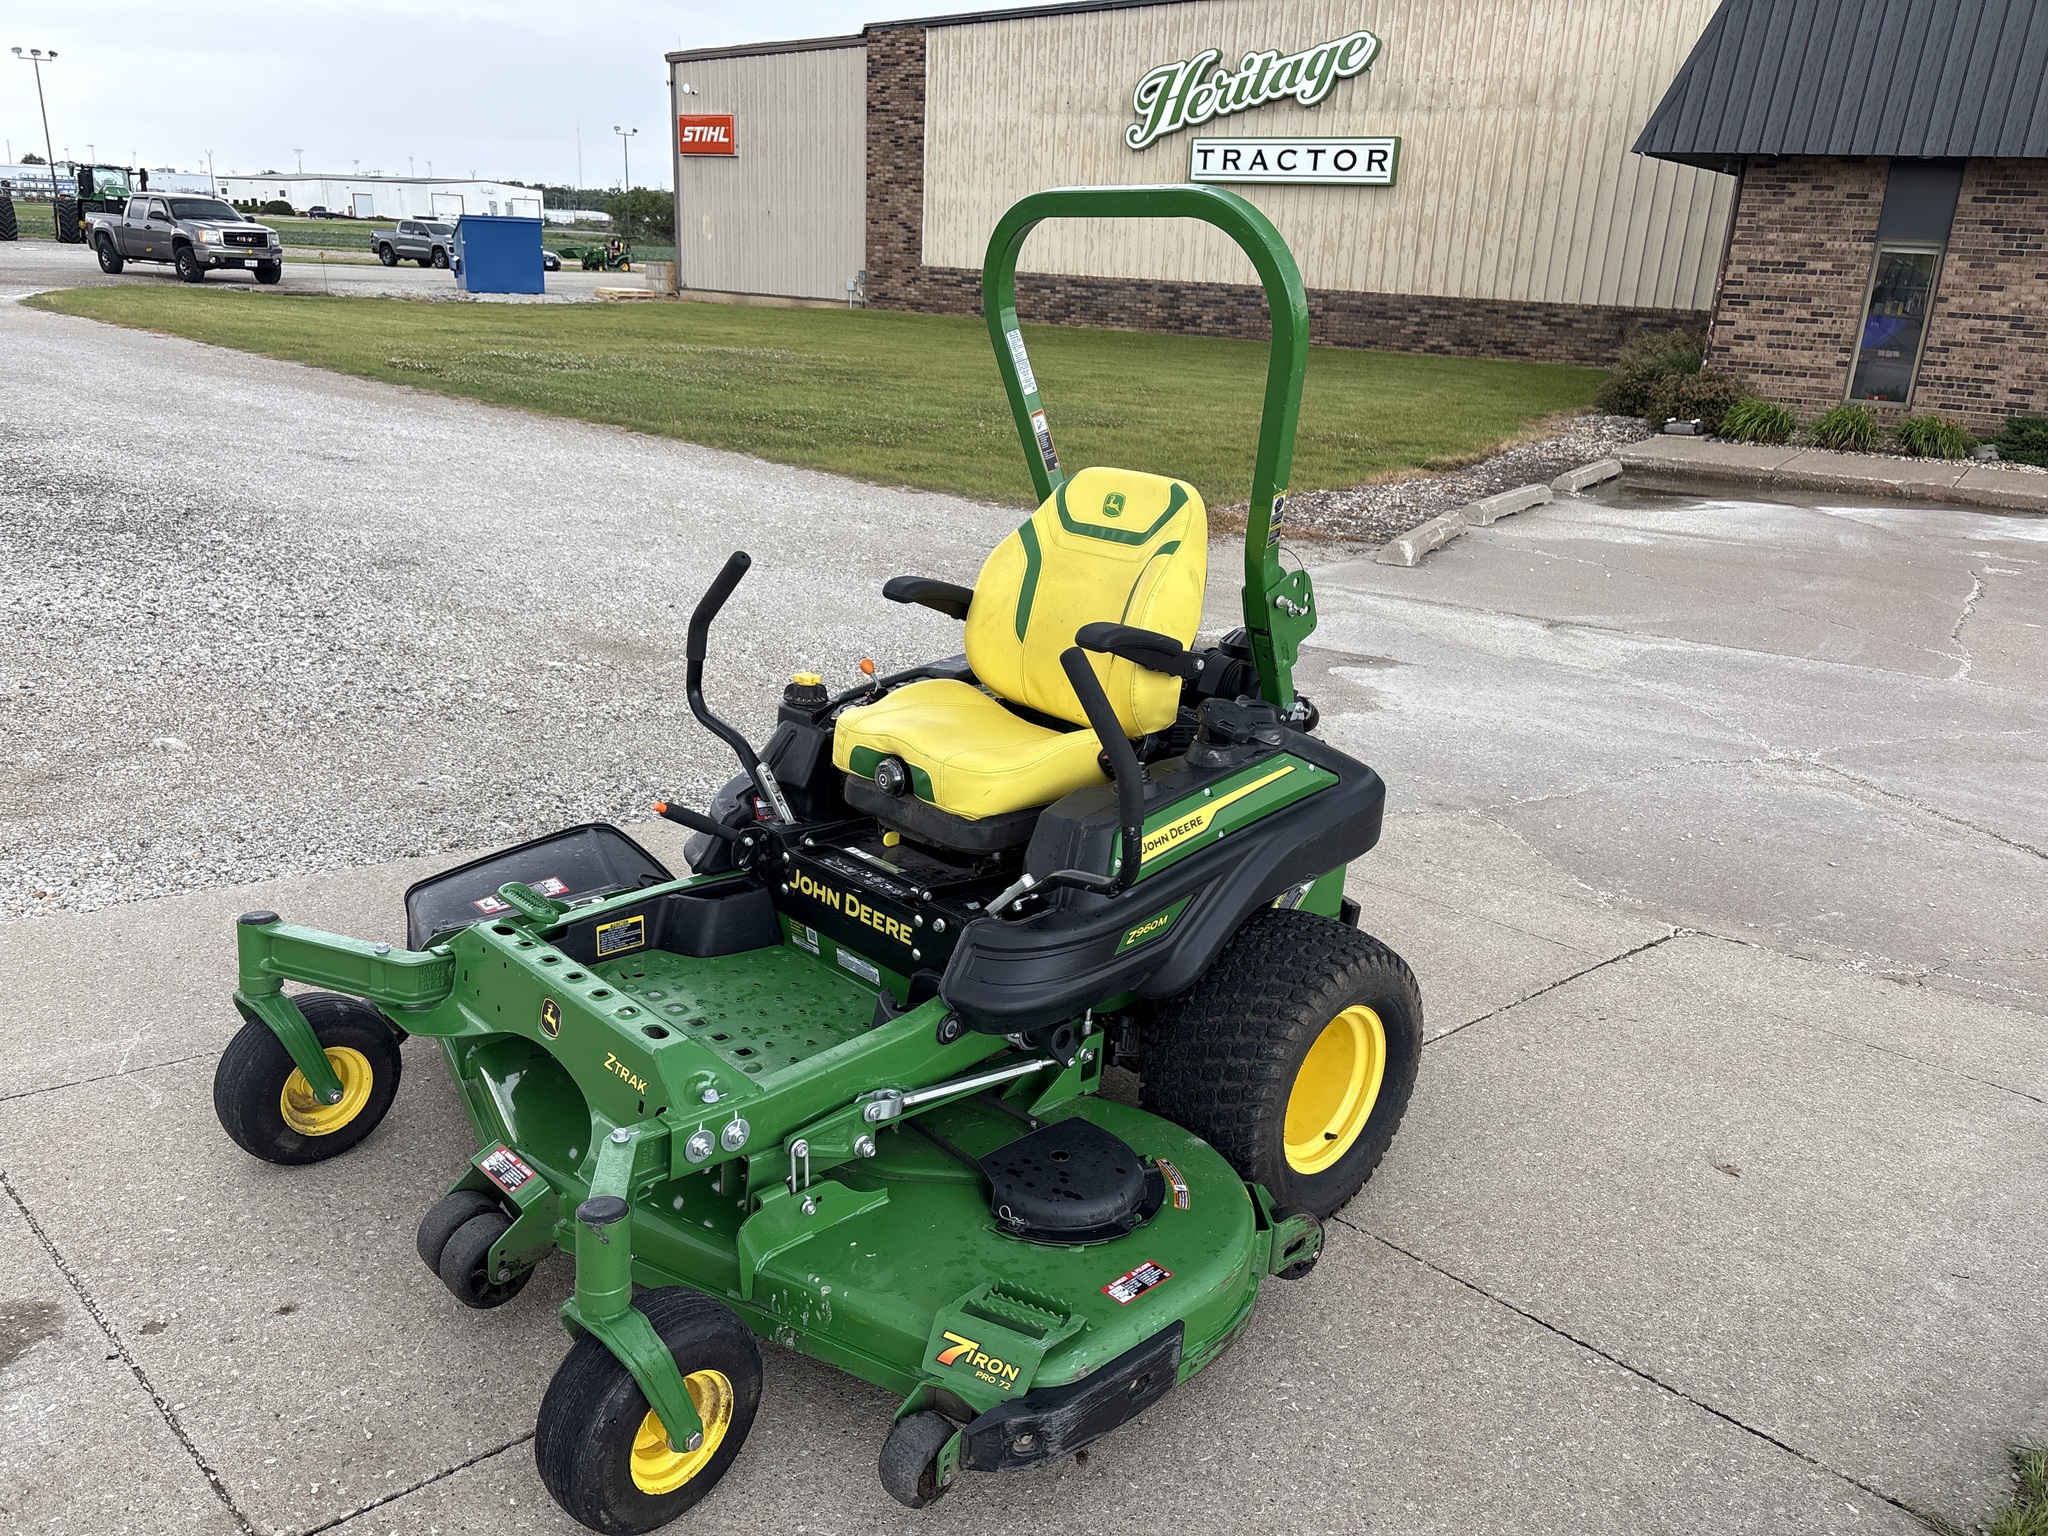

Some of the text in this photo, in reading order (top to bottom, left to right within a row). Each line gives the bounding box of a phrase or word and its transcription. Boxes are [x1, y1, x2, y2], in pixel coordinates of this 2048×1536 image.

[1127, 32, 1378, 147] Heritage
[681, 126, 730, 143] STIHL
[1196, 148, 1389, 172] TRACTOR
[1142, 815, 1204, 855] JOHN DEERE
[789, 868, 841, 910] JOHN
[845, 892, 913, 946] DEERE
[1125, 914, 1169, 946] Z960M
[603, 1051, 648, 1095] ZTRAK
[975, 1370, 997, 1384] PRO
